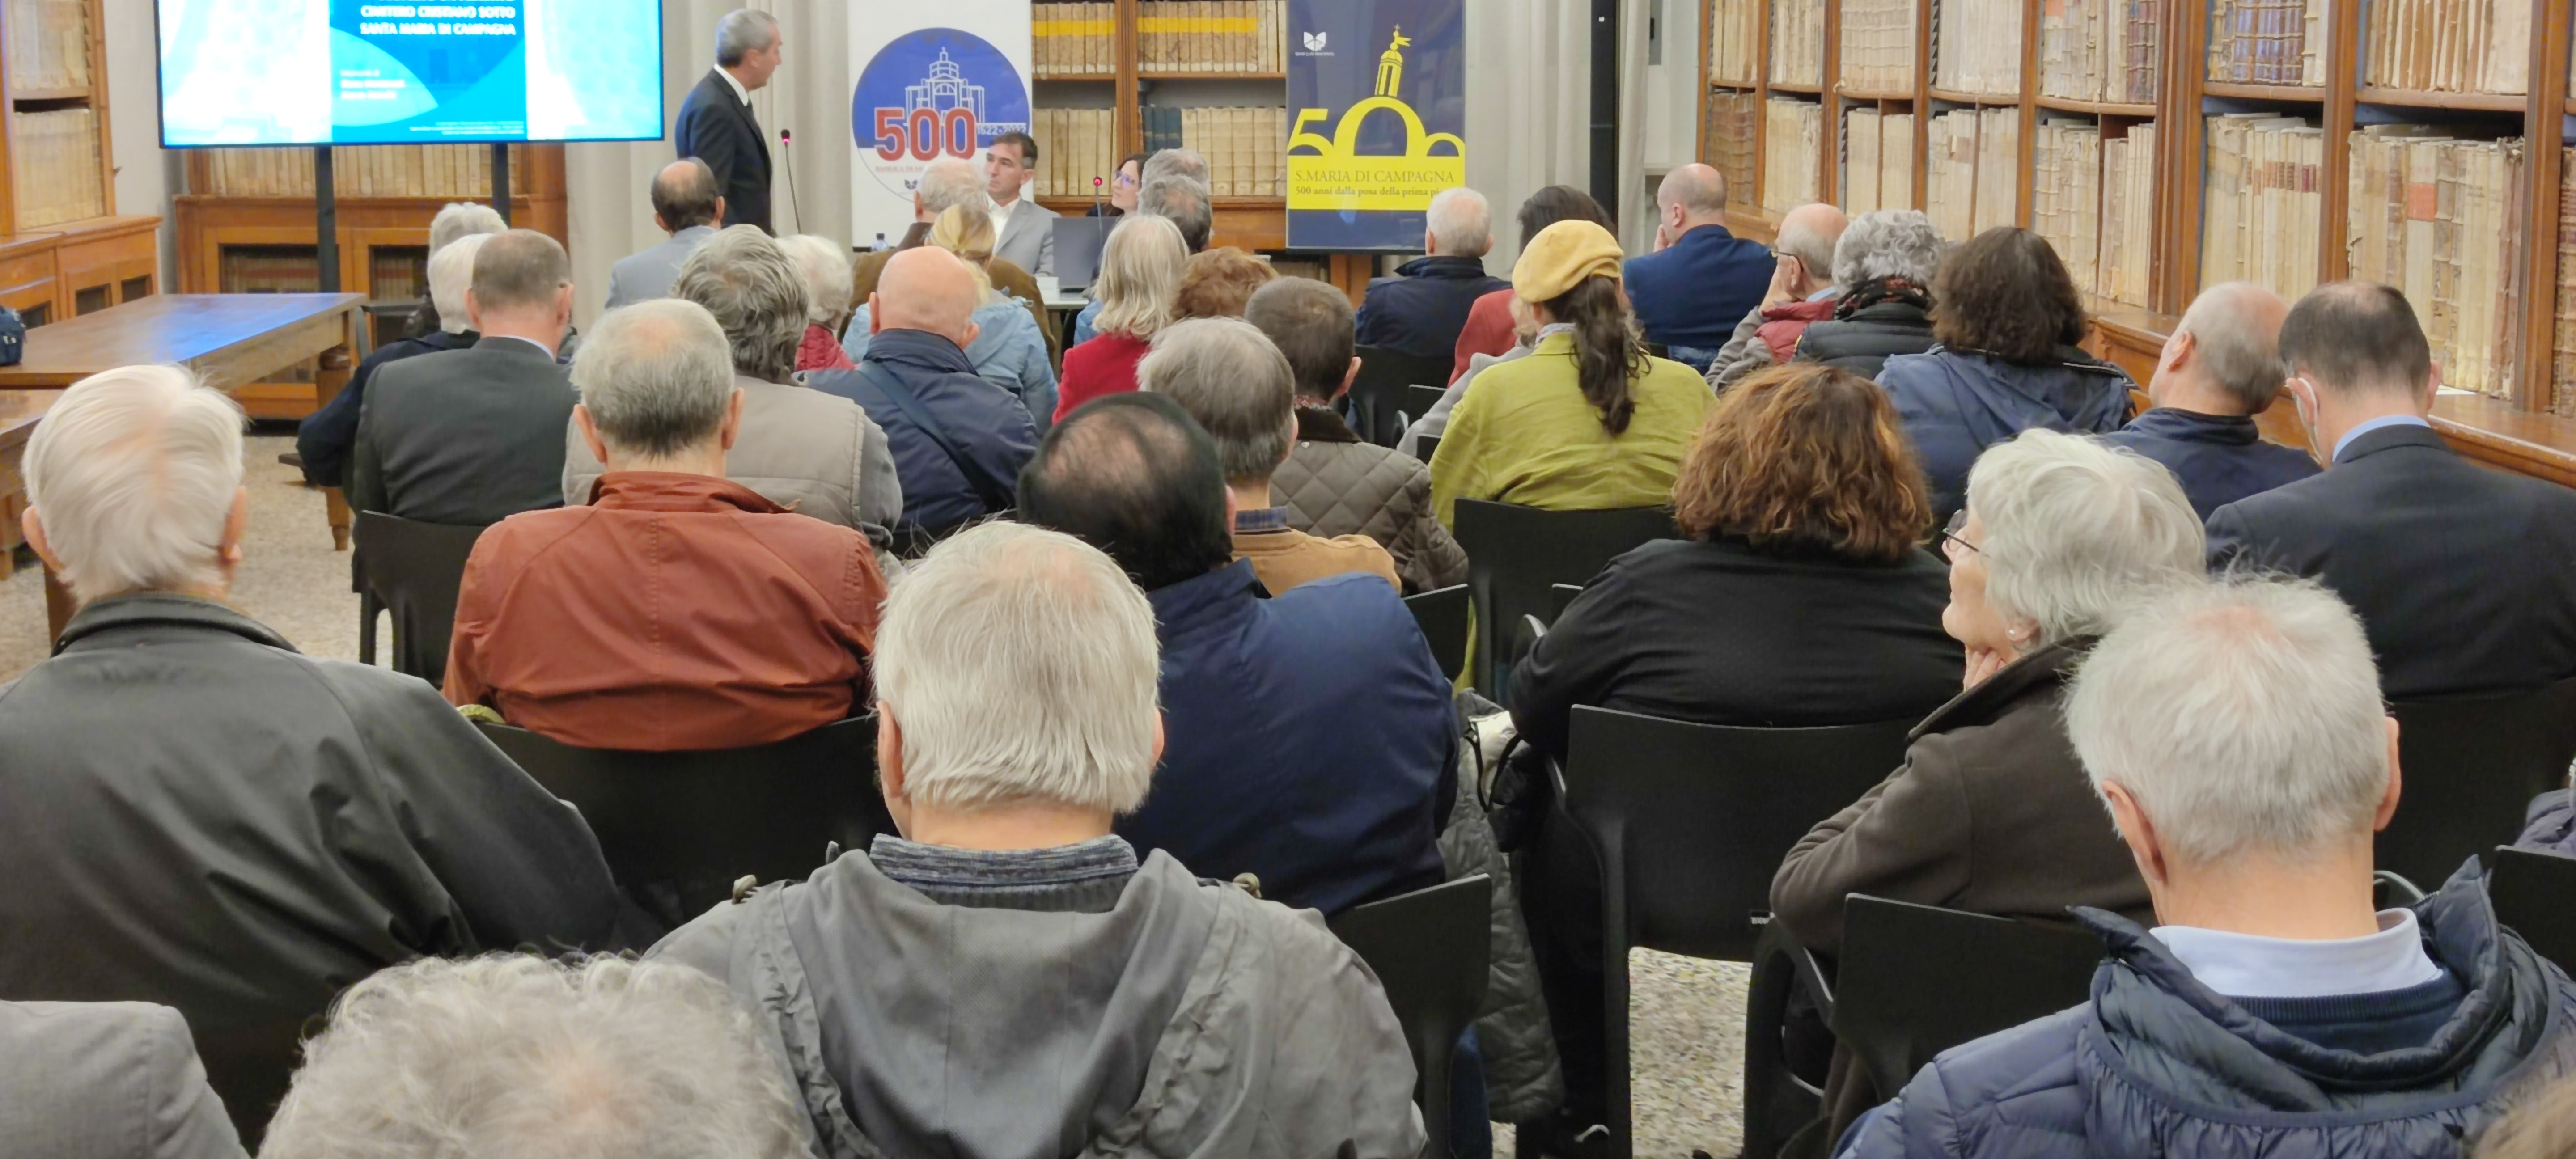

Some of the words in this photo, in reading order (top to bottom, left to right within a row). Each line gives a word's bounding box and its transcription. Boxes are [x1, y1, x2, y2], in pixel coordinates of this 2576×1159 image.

[478, 6, 515, 18] SOTTO
[360, 22, 398, 34] SANTA
[399, 23, 436, 34] MARIA
[453, 23, 516, 35] CAMPAGNA
[1287, 97, 1465, 157] 500
[874, 107, 977, 161] 500
[1355, 170, 1370, 182] DI
[1374, 170, 1454, 182] CAMPAGNA
[1295, 186, 1311, 195] 500
[1335, 186, 1356, 195] dalla
[1358, 189, 1377, 197] posa
[1379, 186, 1400, 195] della
[1402, 187, 1428, 198] prima
